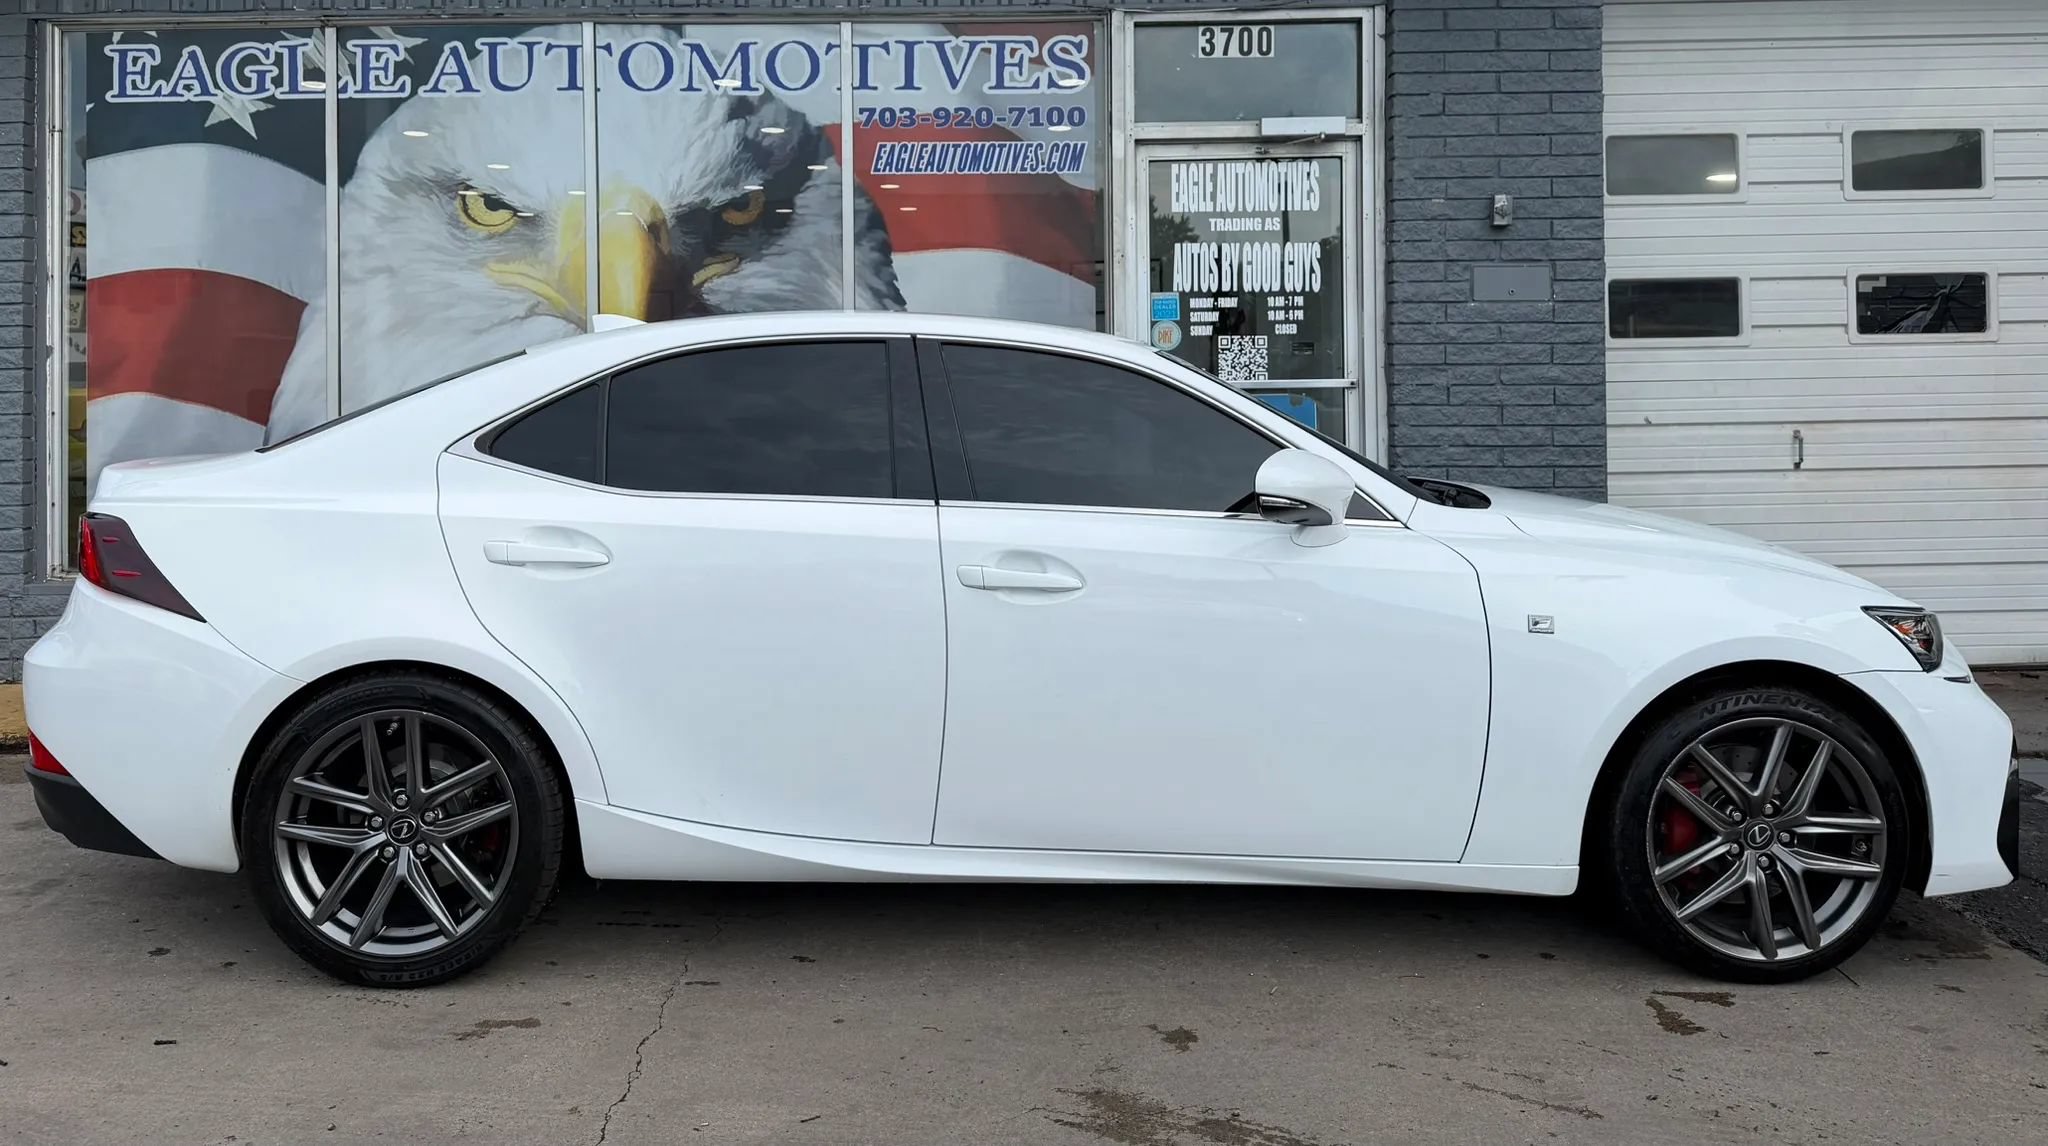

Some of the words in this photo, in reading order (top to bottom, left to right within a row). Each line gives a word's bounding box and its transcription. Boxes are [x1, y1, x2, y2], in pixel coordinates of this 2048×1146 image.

[1199, 26, 1273, 57] 3700
[106, 39, 410, 102] EAGLE
[423, 34, 1089, 97] AUTOMOTIVES
[859, 105, 1087, 130] 703-920-7100
[871, 141, 1088, 175] EAGLEAUTOMOTIVES.COM
[1171, 162, 1213, 213] EAGLE
[1216, 161, 1320, 212] AUTOMOTIVES
[1209, 218, 1262, 231] TRADING
[1264, 217, 1281, 231] AS
[1173, 241, 1219, 292] AUTOS
[1221, 242, 1240, 292] BY
[1242, 241, 1281, 292] GOOD
[1284, 241, 1321, 292] GUYS
[1190, 298, 1214, 308] MONDAY
[1218, 297, 1238, 308] FRIDAY
[1267, 296, 1275, 307] 10
[1275, 296, 1285, 306] AM
[1294, 296, 1304, 306] PM
[1190, 311, 1219, 322] SATURDAY
[1267, 310, 1275, 321] 10
[1275, 310, 1285, 320] AM
[1294, 310, 1304, 320] PM
[1190, 325, 1213, 336] SUNDAY
[1275, 323, 1297, 335] CLOSED
